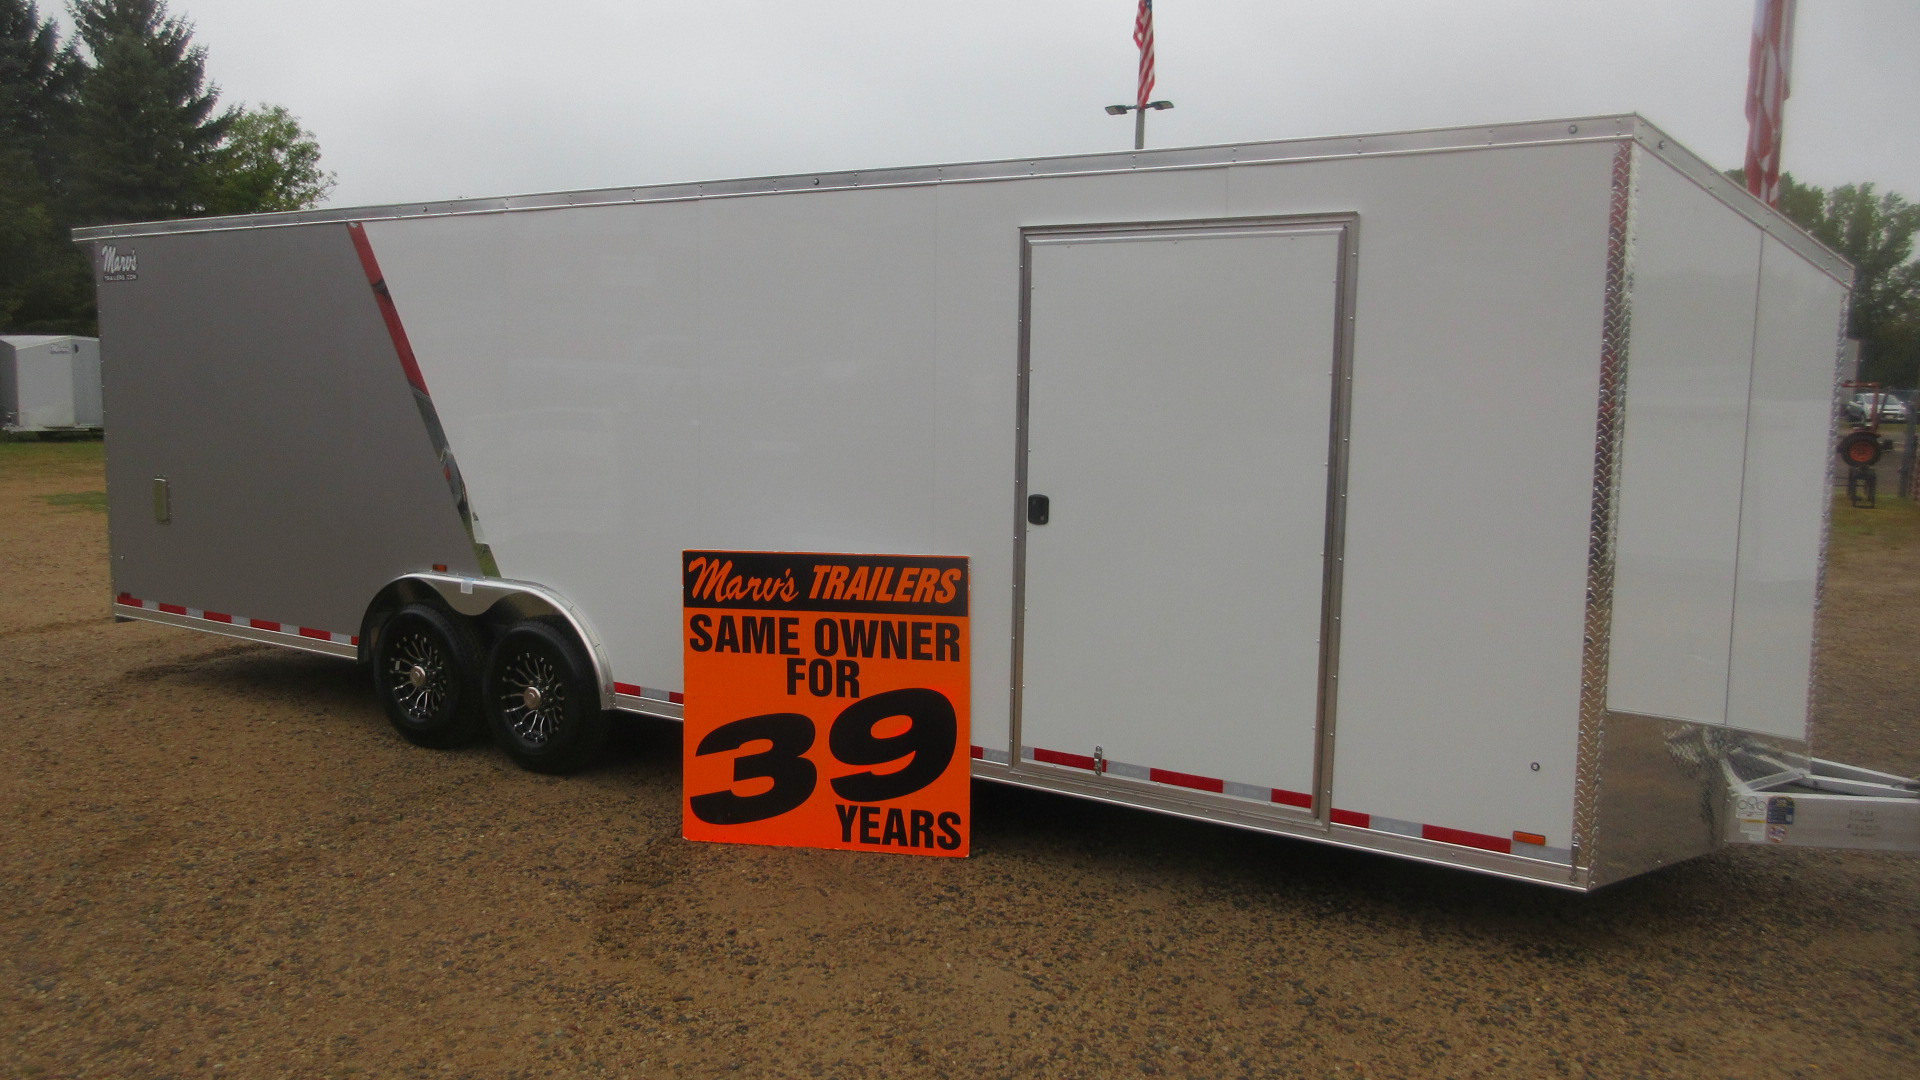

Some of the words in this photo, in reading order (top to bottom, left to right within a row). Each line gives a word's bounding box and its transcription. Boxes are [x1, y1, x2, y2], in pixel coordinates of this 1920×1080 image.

[688, 556, 799, 602] Marv's
[808, 564, 961, 604] TRAILERS
[689, 614, 800, 655] SAME
[814, 618, 961, 662] OWNER
[786, 658, 860, 698] FOR
[689, 687, 957, 825] 39
[835, 804, 961, 850] YEARS
